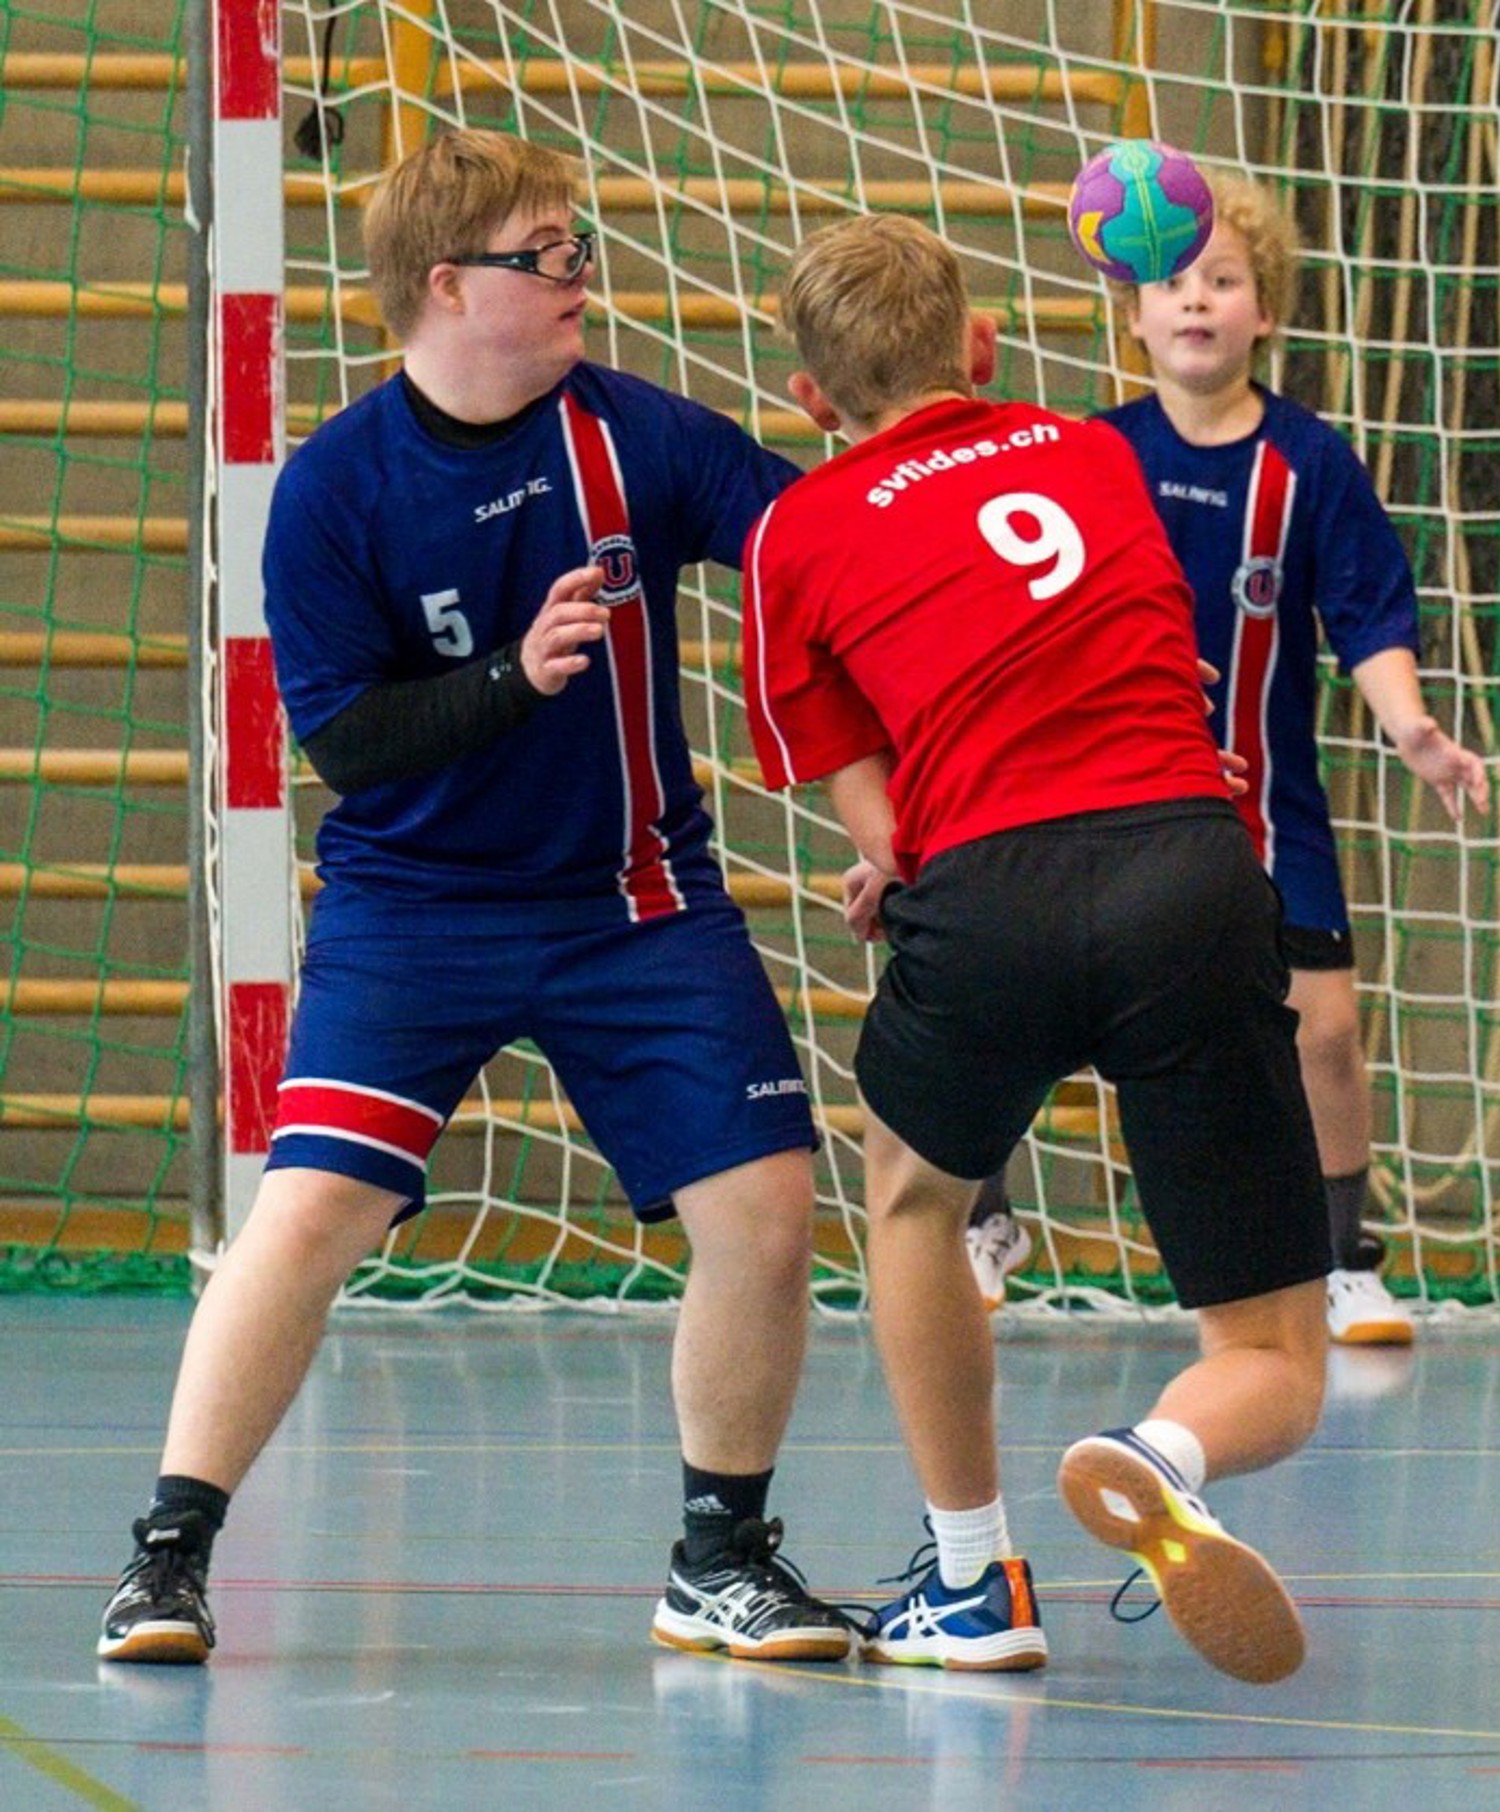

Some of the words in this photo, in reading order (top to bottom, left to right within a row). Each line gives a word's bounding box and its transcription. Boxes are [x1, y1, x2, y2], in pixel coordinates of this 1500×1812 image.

[867, 424, 1060, 508] svfides.ch
[977, 492, 1087, 600] 9
[419, 588, 473, 657] 5
